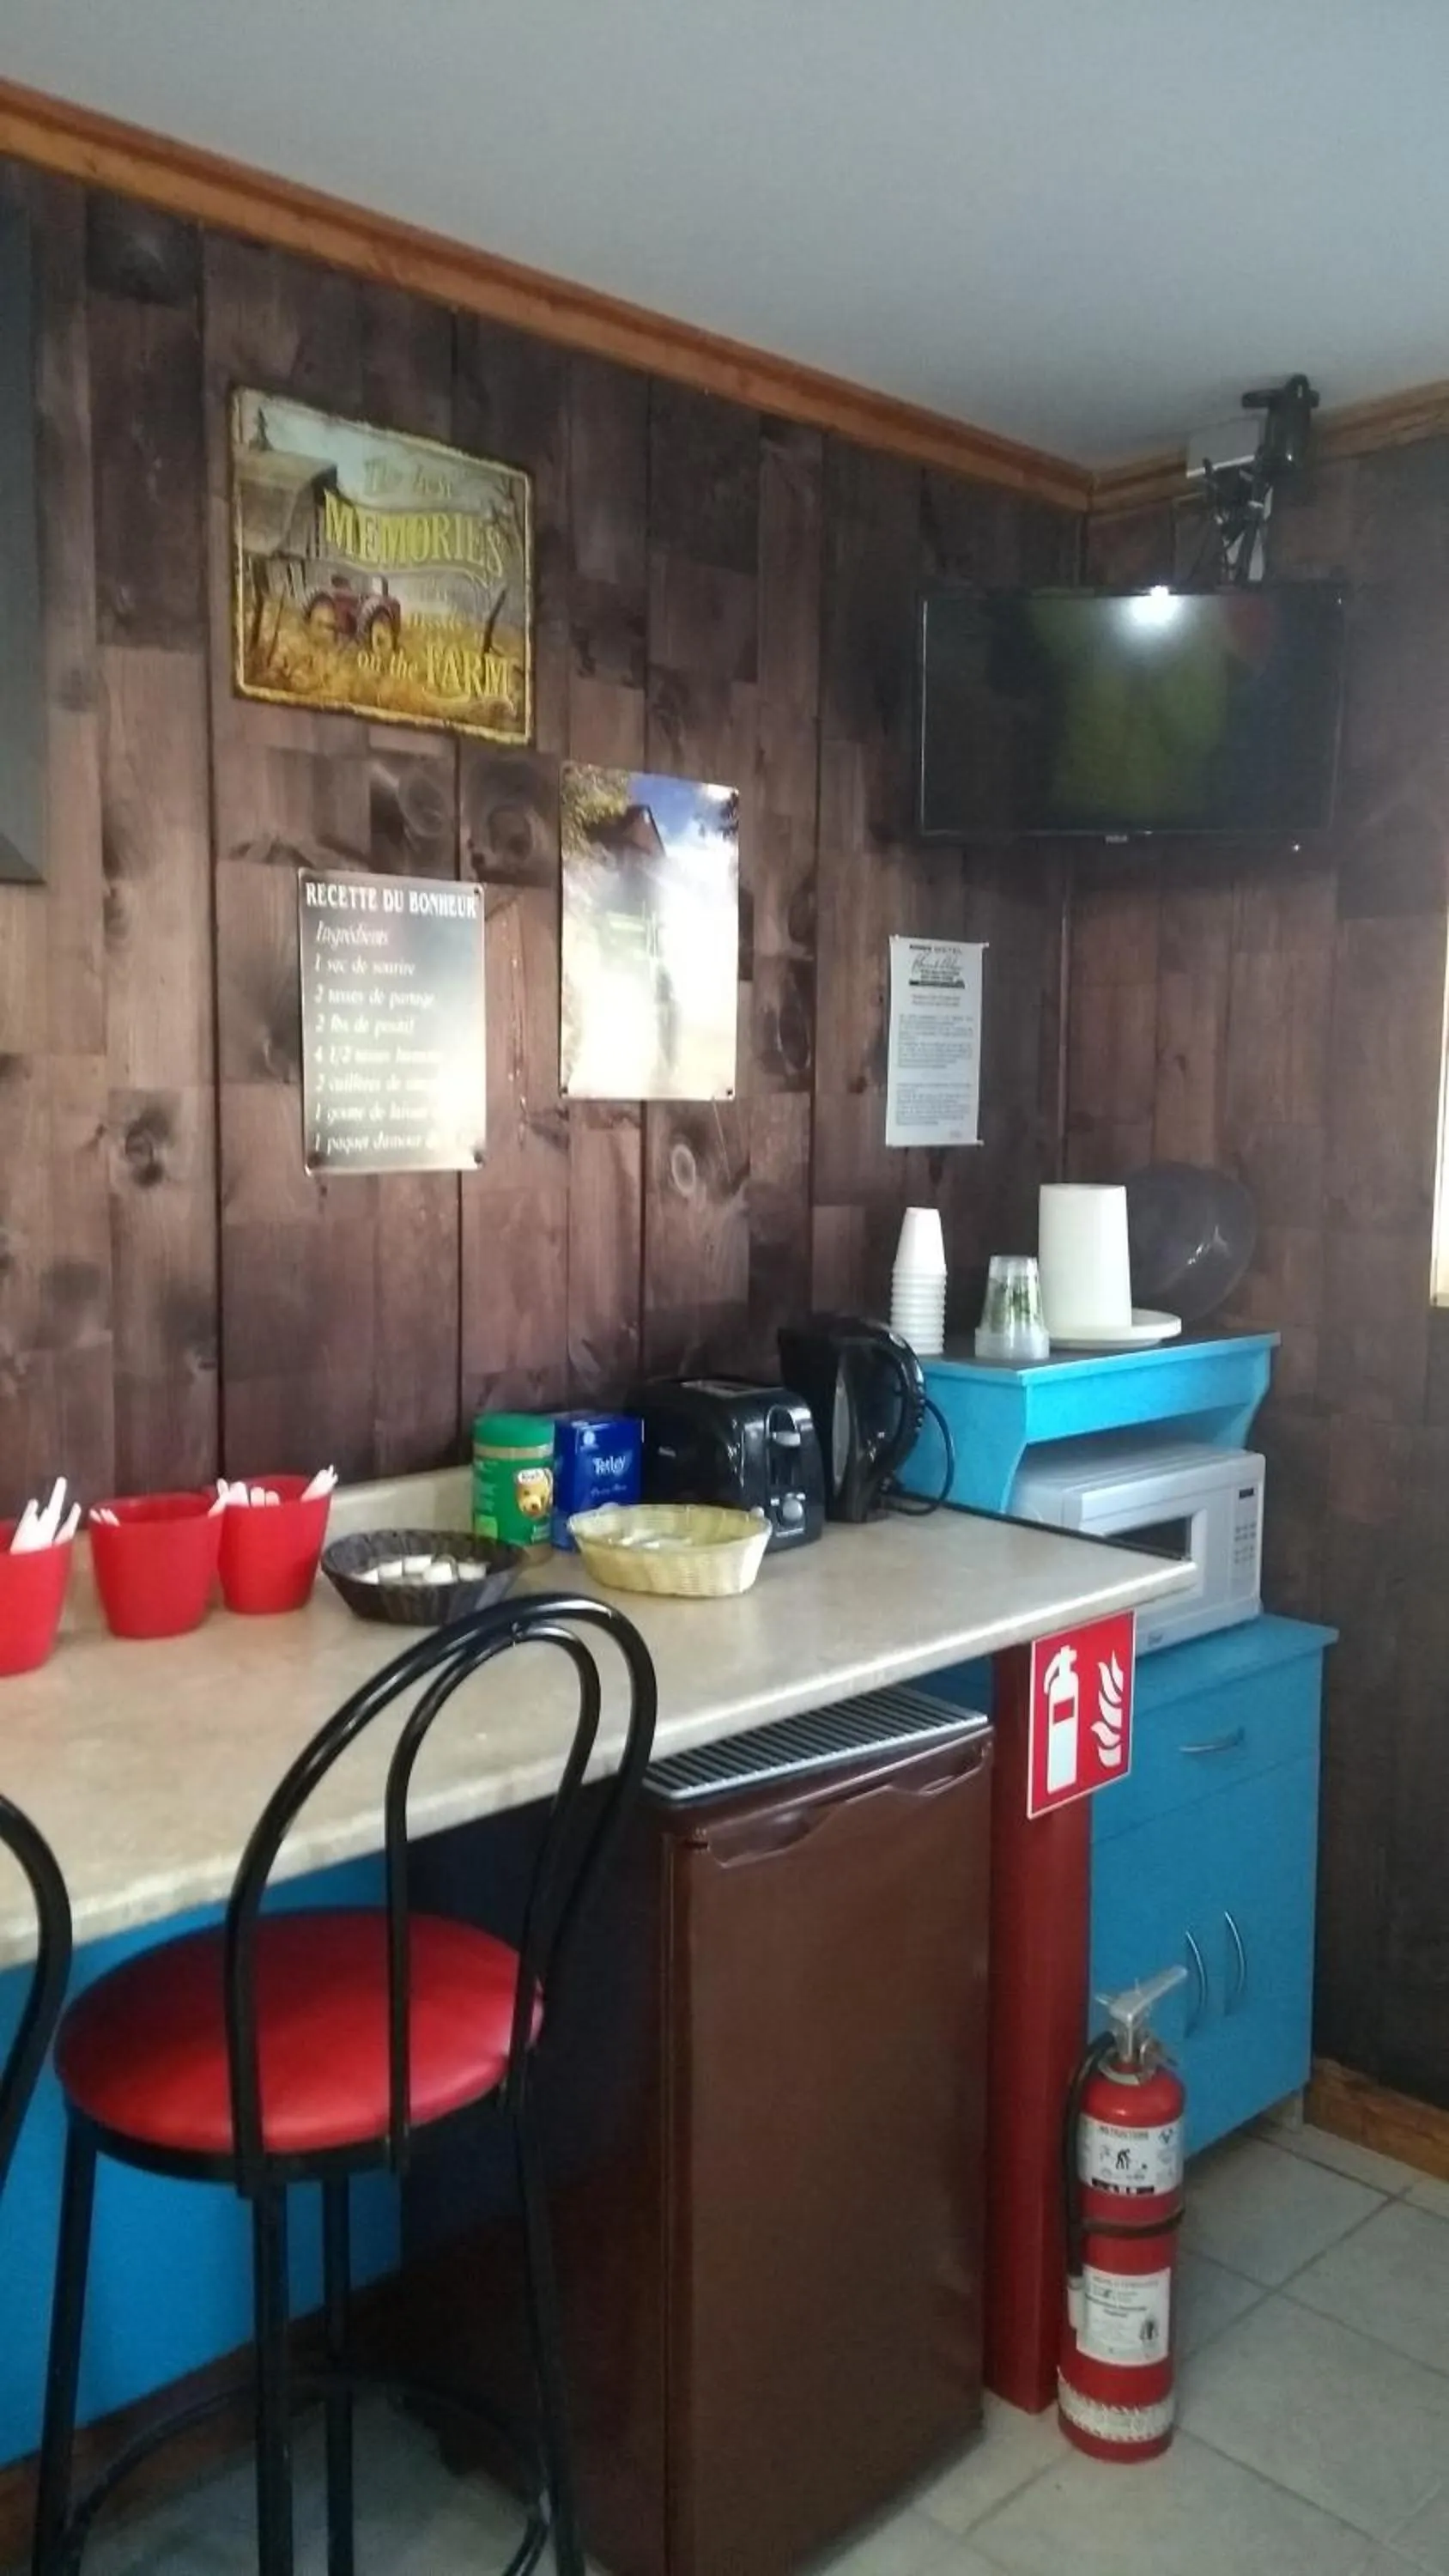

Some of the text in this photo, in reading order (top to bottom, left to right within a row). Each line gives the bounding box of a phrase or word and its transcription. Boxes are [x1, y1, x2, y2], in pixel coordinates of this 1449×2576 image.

[324, 489, 505, 578] MEMORIES
[357, 642, 512, 697] on the FARM
[306, 882, 478, 919] RECETTE DU BONHEUR
[352, 955, 367, 975] de
[369, 986, 385, 1005] de
[354, 1014, 370, 1034] de
